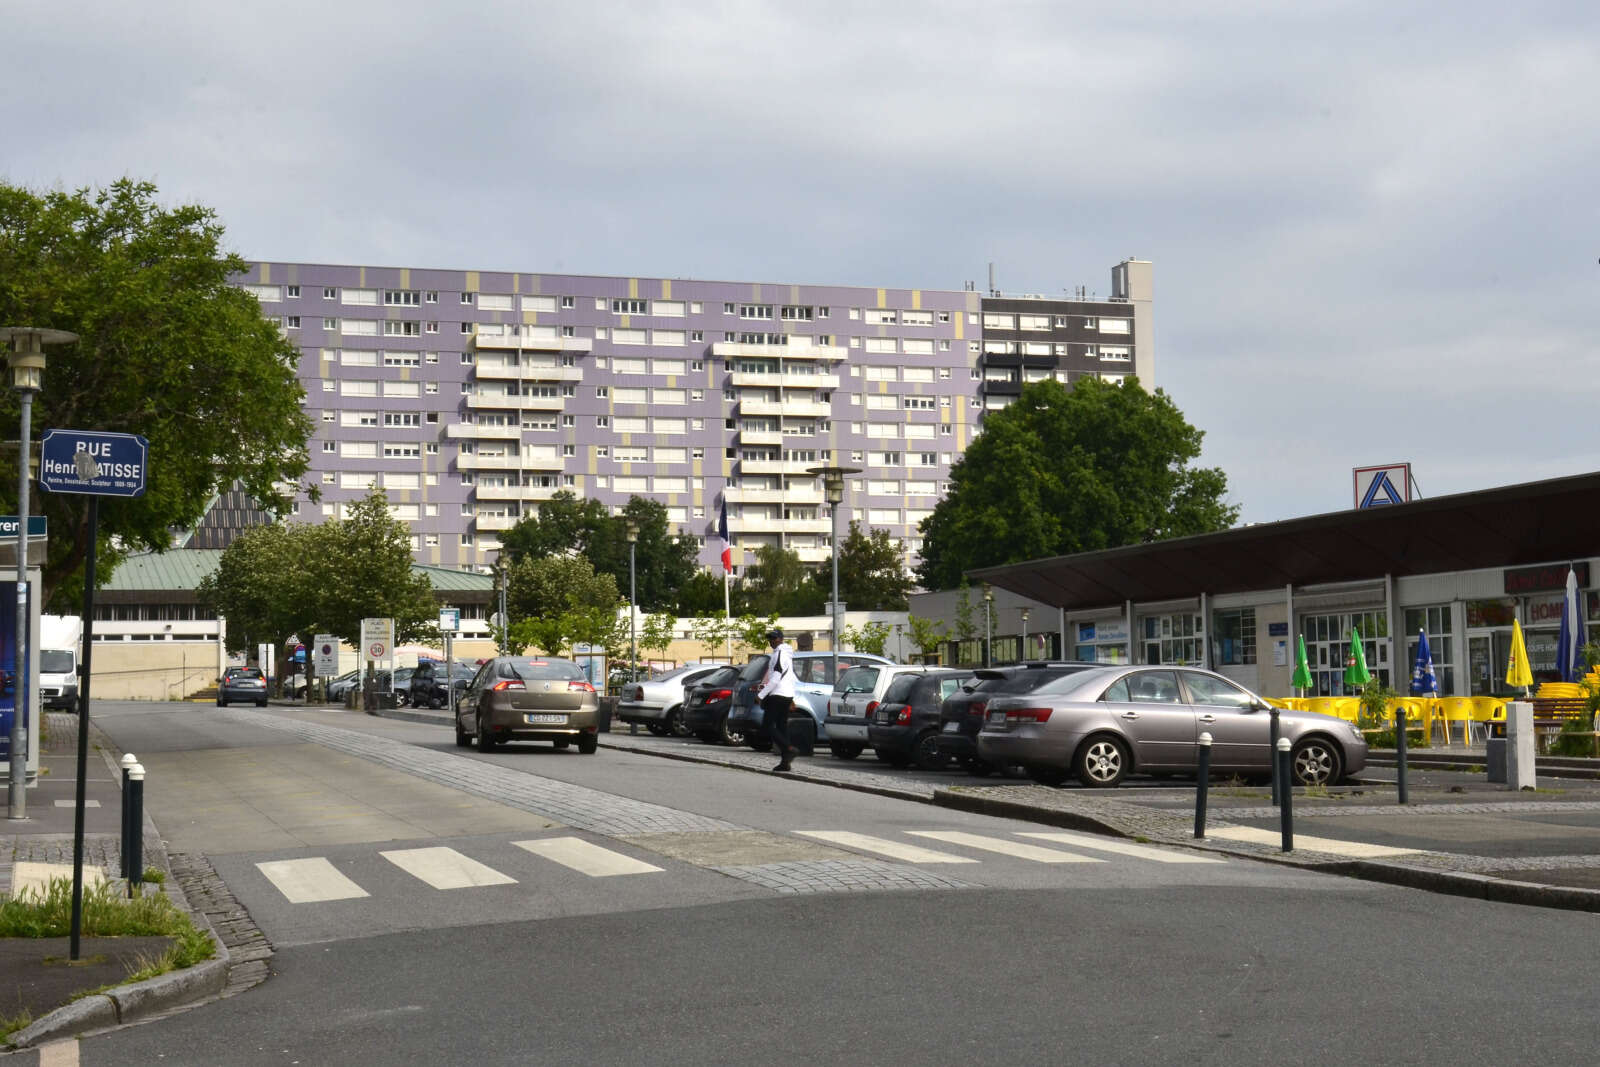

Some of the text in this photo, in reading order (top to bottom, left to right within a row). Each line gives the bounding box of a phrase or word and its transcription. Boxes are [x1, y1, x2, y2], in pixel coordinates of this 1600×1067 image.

[76, 441, 112, 457] RUE
[45, 459, 140, 479] Henr ATISSE
